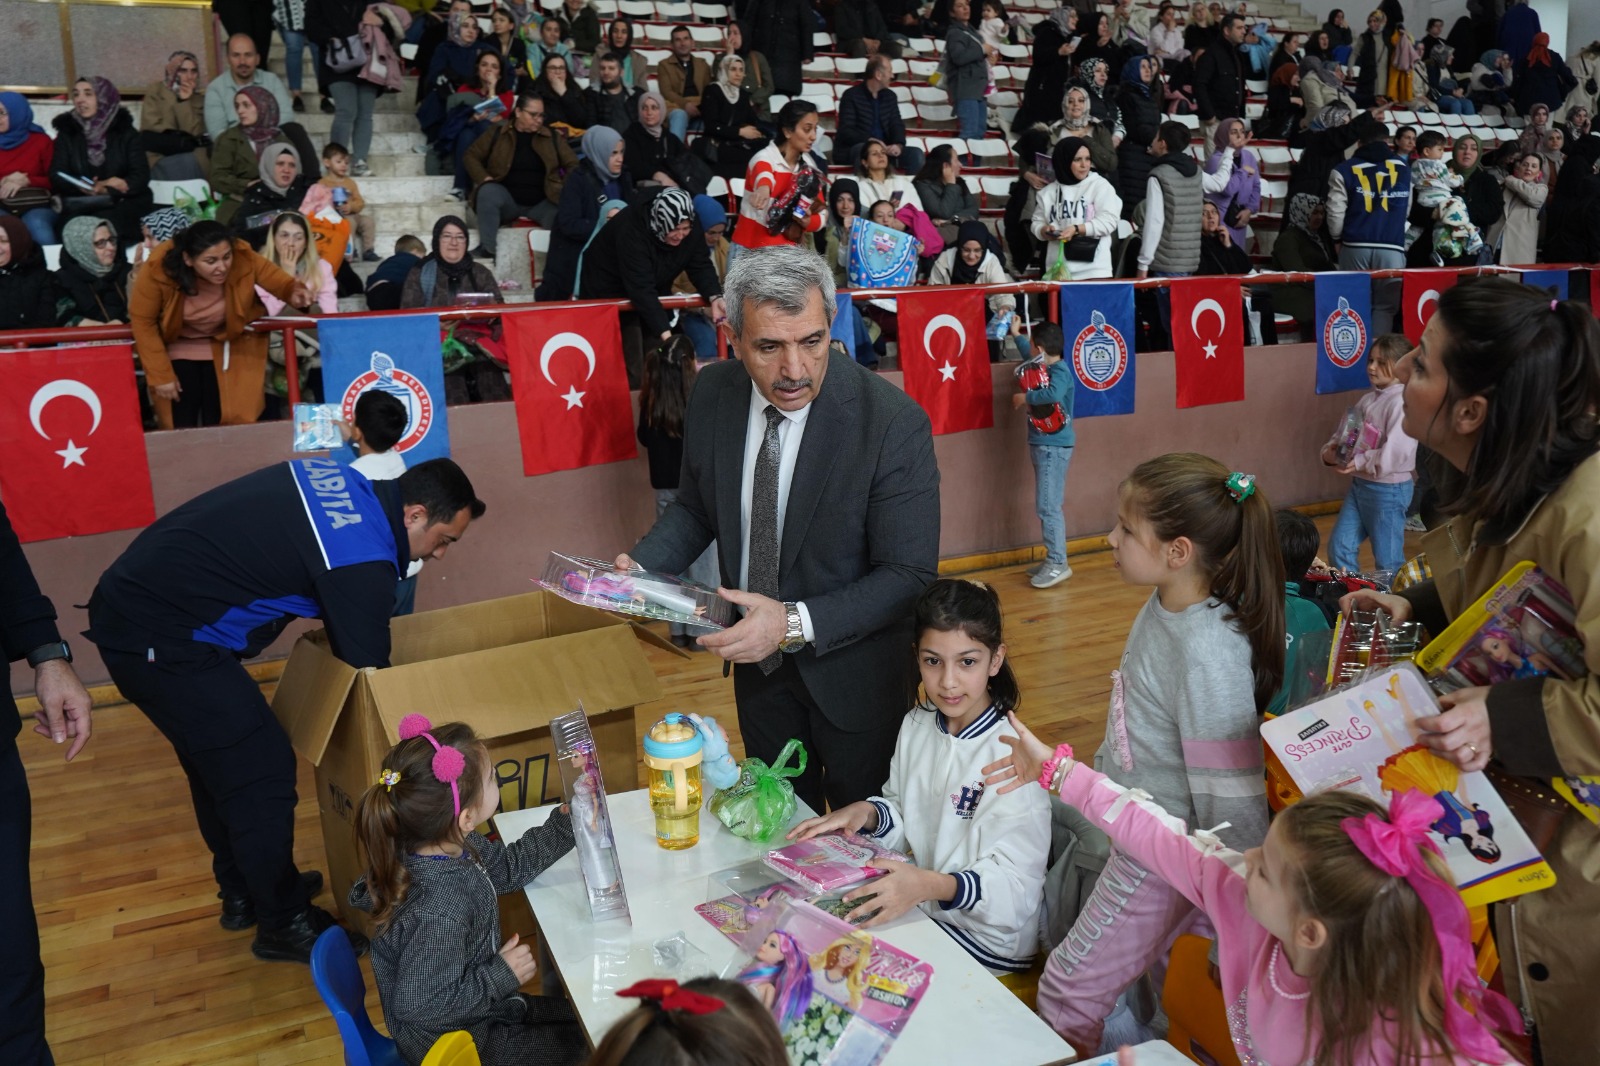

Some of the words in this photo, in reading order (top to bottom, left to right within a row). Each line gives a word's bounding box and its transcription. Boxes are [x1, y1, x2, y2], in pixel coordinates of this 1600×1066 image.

[302, 459, 363, 530] ZABITA
[1284, 716, 1372, 761] PRINCESS
[1332, 740, 1353, 753] CUTE
[1054, 855, 1148, 976] UNICORN
[867, 987, 909, 1007] FASHION
